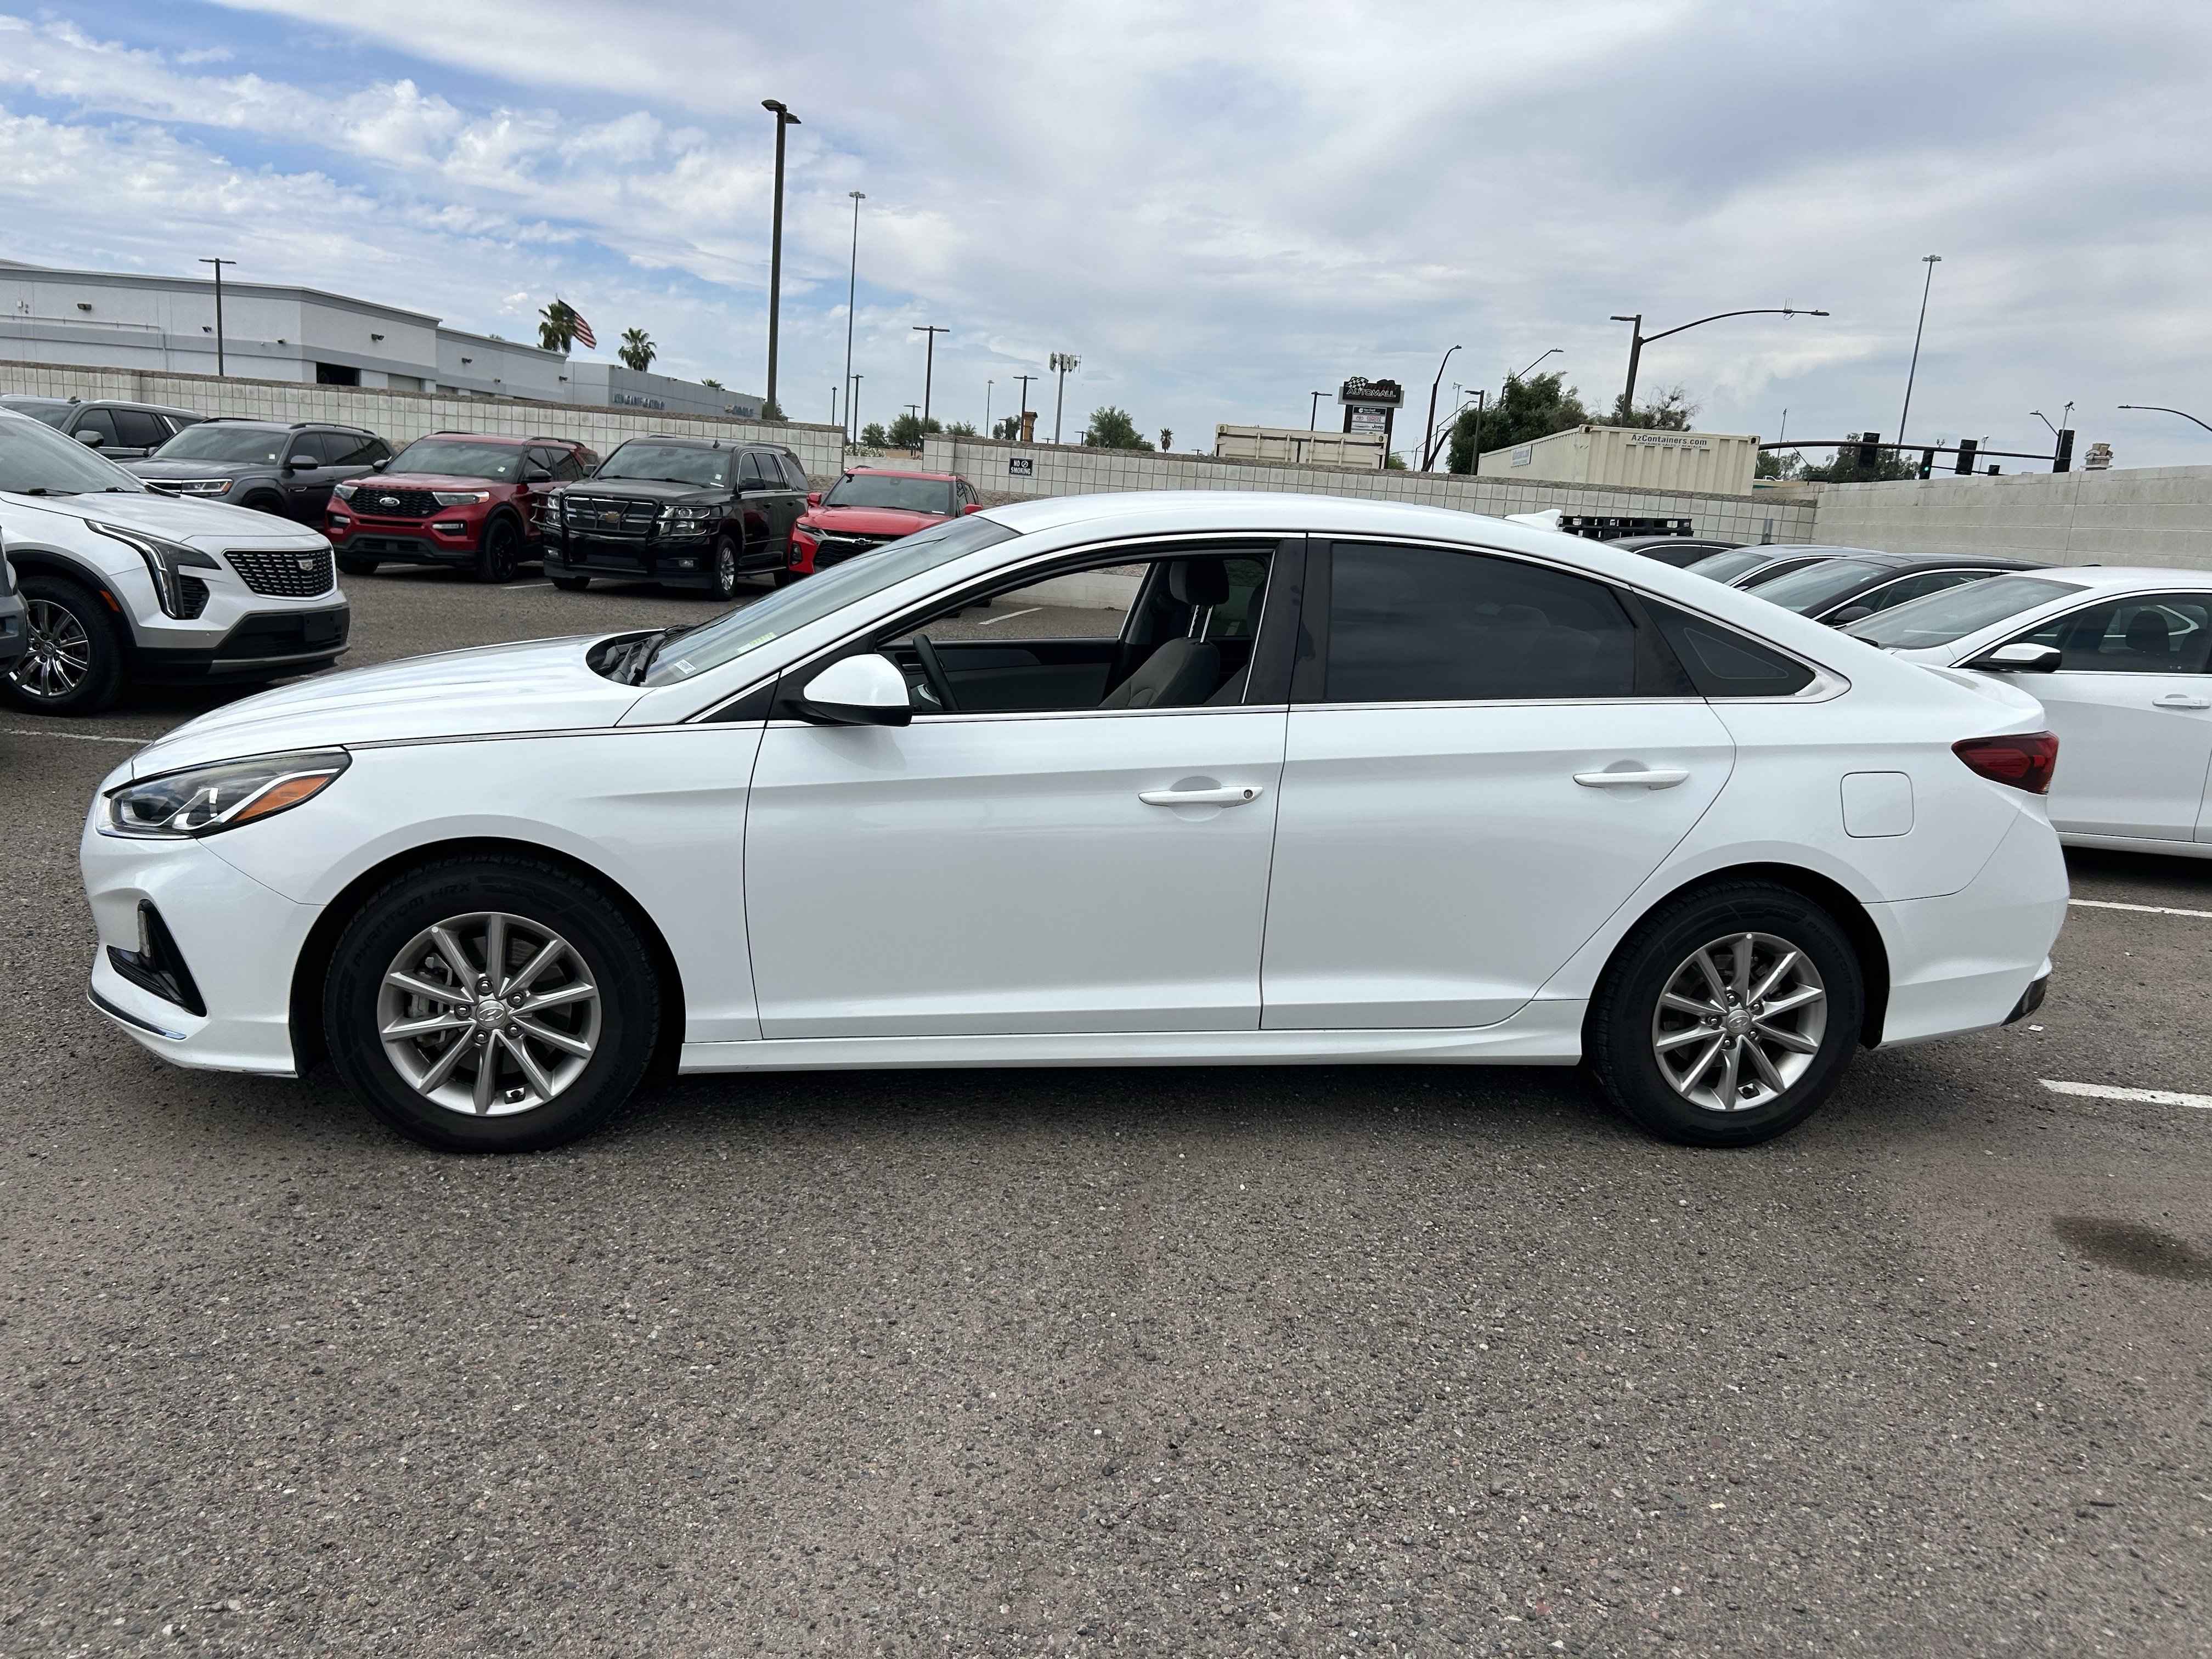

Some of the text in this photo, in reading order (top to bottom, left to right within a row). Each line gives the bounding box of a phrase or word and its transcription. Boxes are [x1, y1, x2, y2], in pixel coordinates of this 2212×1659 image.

[1346, 388, 1396, 398] AUTOMALL
[1631, 434, 1707, 445] AzContainers.com
[1011, 466, 1031, 475] SMOKING
[352, 881, 472, 967] PHANTOM HRX
